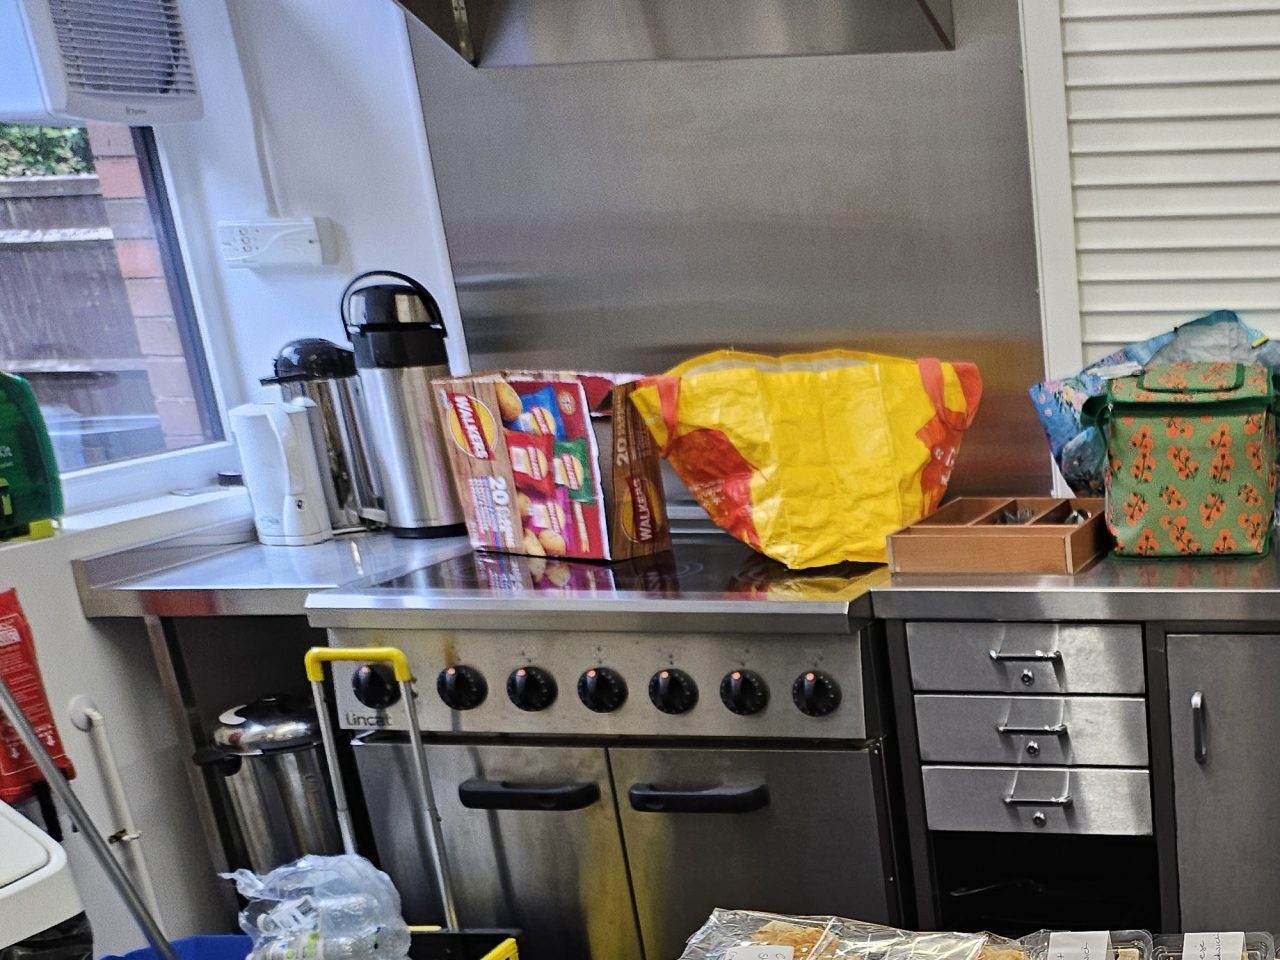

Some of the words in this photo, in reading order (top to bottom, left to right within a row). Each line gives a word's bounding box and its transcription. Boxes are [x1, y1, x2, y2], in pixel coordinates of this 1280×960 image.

[454, 395, 489, 460] WALKERS
[615, 437, 629, 466] 20
[489, 476, 509, 505] 20
[632, 477, 653, 541] WALKERS
